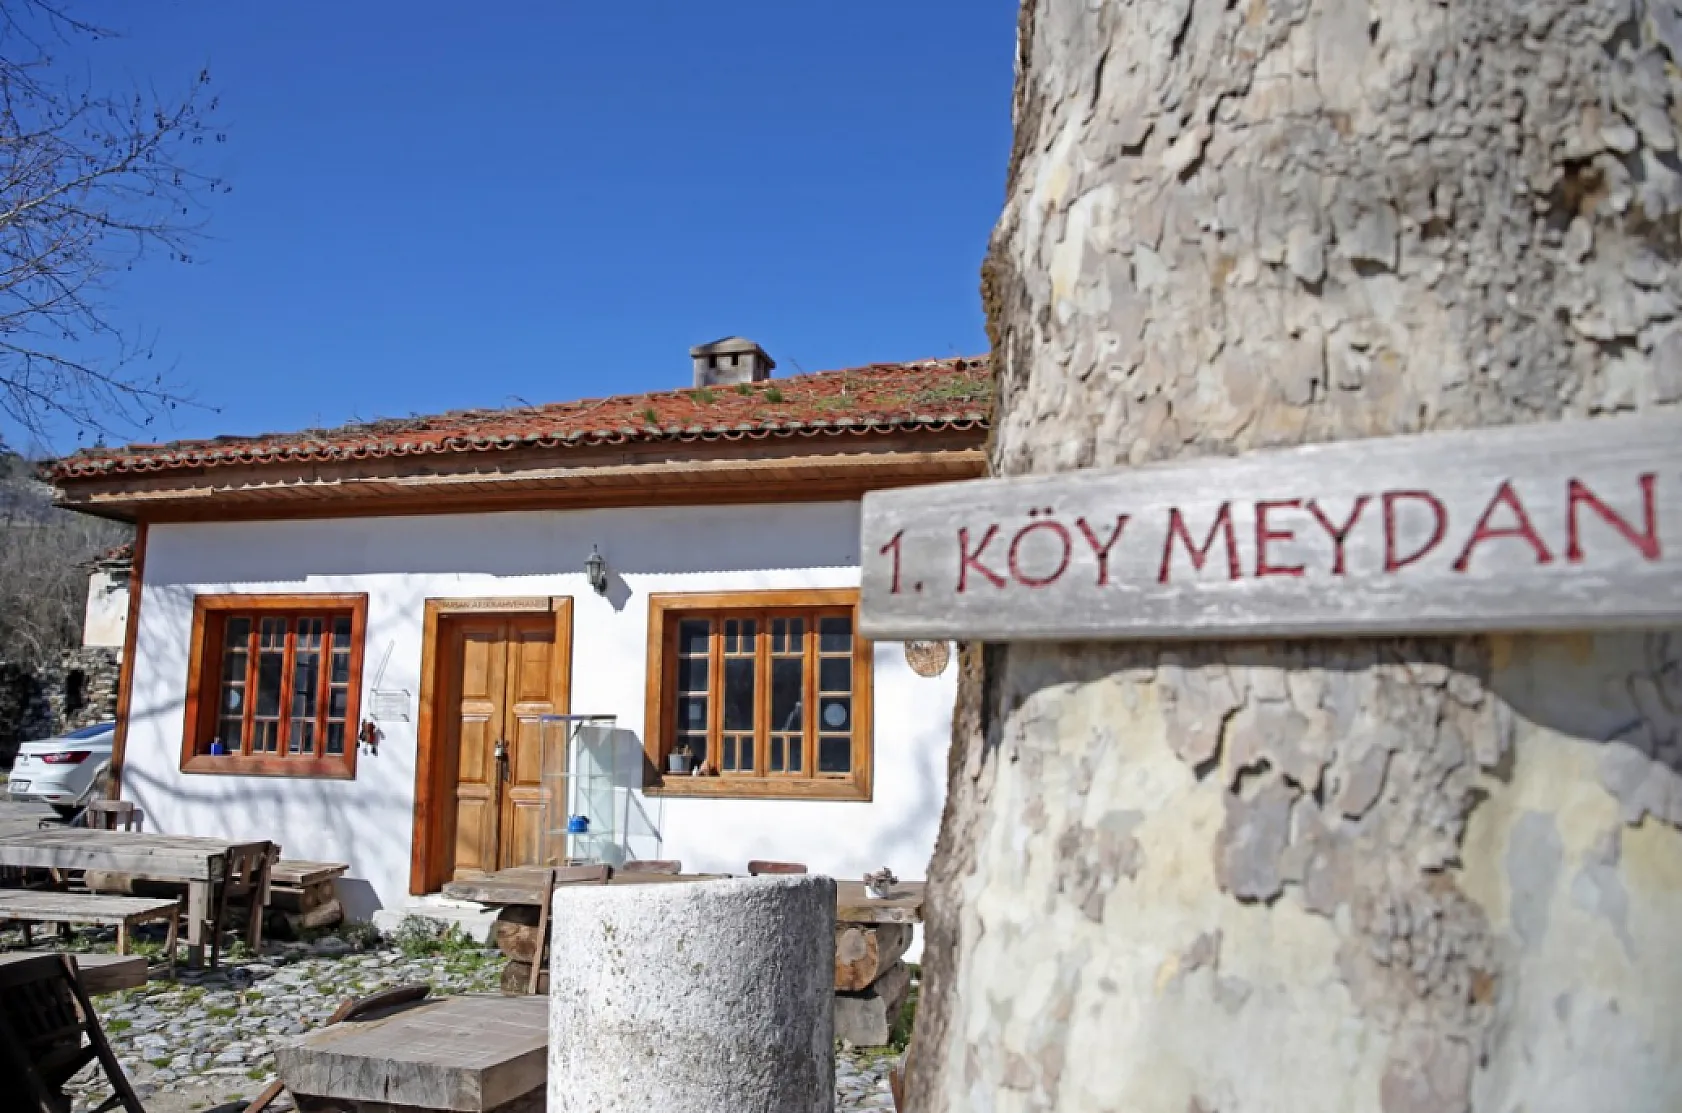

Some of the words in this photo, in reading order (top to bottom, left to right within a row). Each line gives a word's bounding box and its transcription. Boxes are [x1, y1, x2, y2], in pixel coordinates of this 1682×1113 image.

[879, 528, 924, 594] 1.
[956, 507, 1130, 593] KÖY
[1157, 472, 1663, 585] MEYDAN
